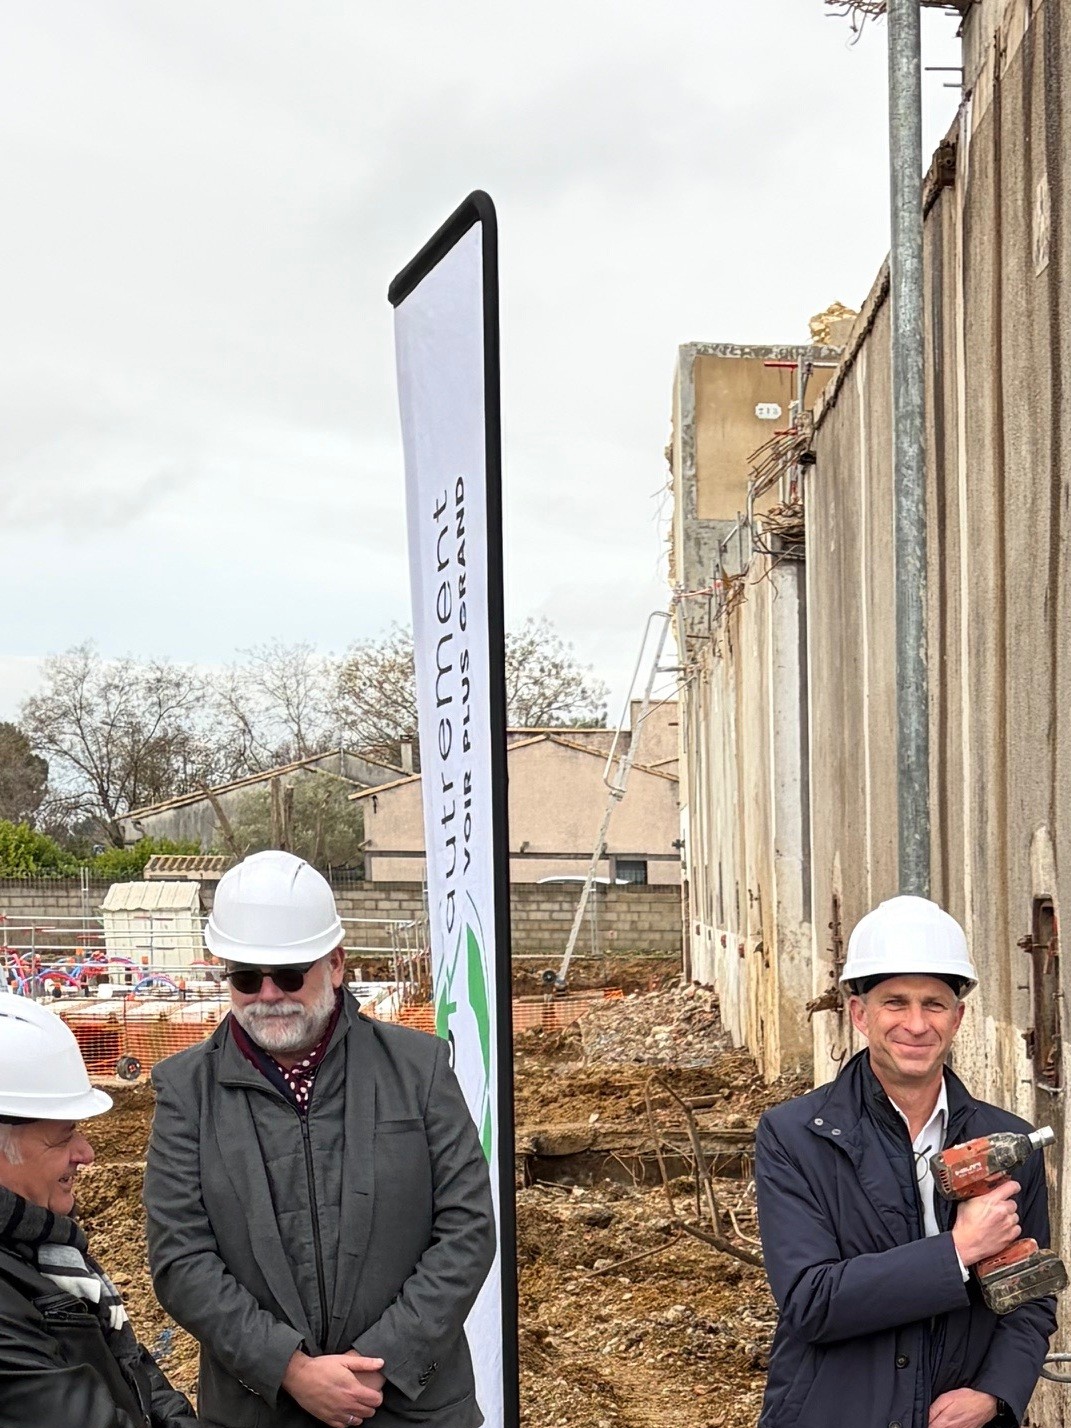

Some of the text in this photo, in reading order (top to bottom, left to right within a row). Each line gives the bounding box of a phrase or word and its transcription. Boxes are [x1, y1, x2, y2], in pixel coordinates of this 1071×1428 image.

[433, 489, 456, 934] autrement
[455, 476, 472, 876] VOIR PLUS GRAND
